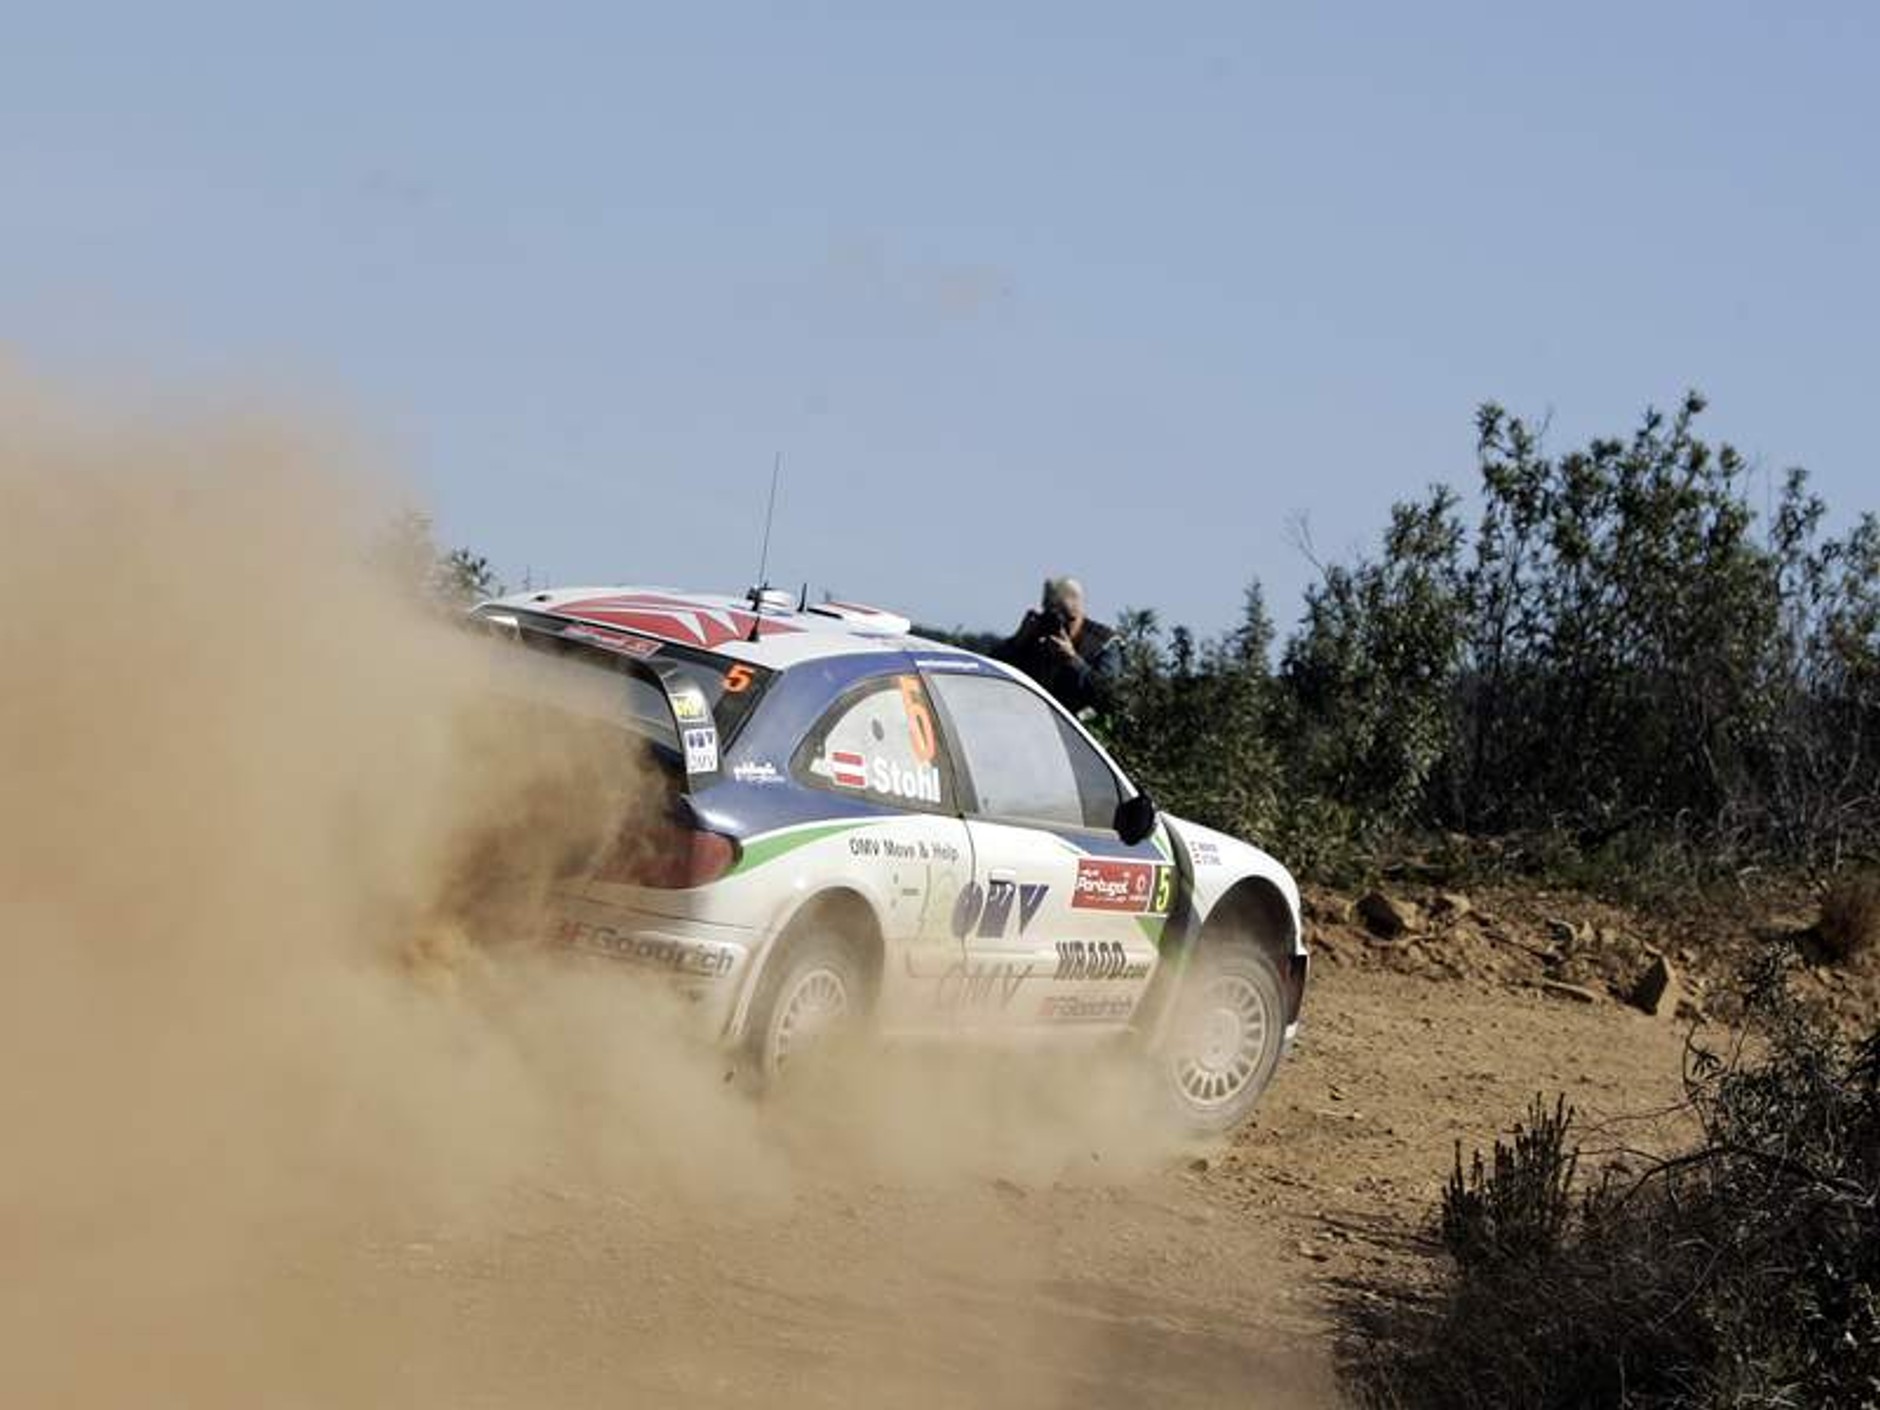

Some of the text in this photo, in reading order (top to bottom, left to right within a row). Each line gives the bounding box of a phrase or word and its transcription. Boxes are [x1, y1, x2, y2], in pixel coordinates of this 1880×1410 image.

[724, 664, 754, 692] 5
[873, 757, 941, 803] Stohl
[849, 838, 880, 856] OMV
[883, 839, 916, 859] Move
[931, 842, 959, 865] Help
[1079, 876, 1129, 897] Portugal
[1156, 866, 1170, 911] 5
